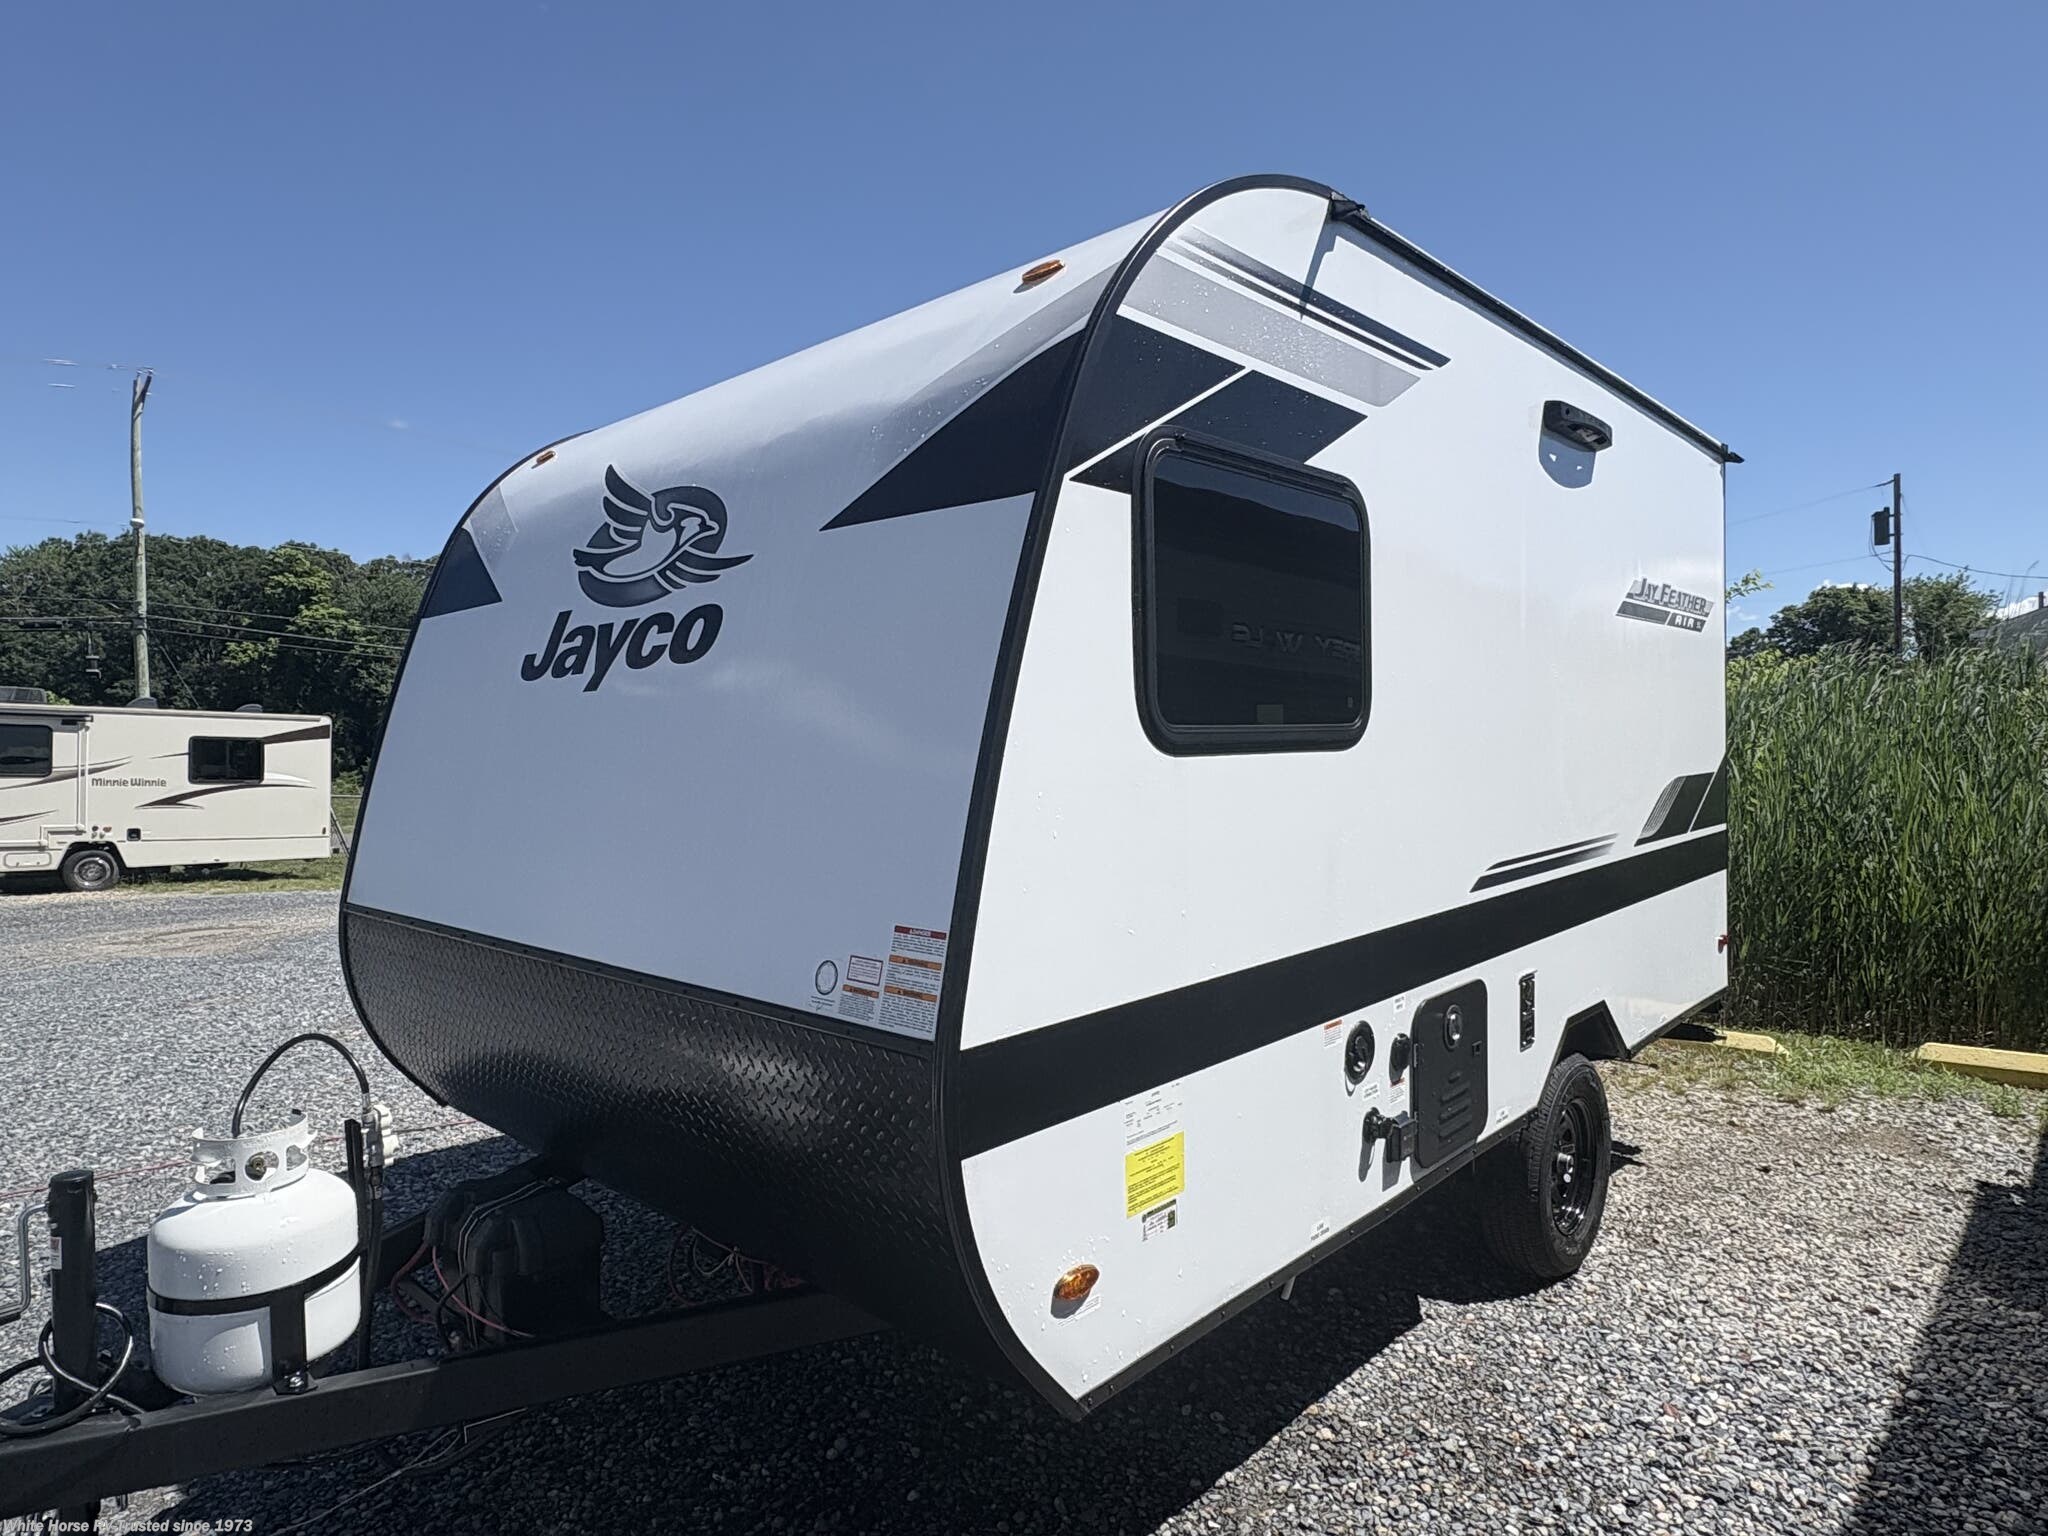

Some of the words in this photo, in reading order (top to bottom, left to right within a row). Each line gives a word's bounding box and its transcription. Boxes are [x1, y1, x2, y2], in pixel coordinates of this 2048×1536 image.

[1634, 578, 1659, 600] JAY
[1660, 584, 1706, 613] FEATHER
[1675, 615, 1694, 628] AIR
[521, 603, 724, 693] Jayco
[91, 777, 129, 787] Minnie
[130, 777, 167, 787] Winnie
